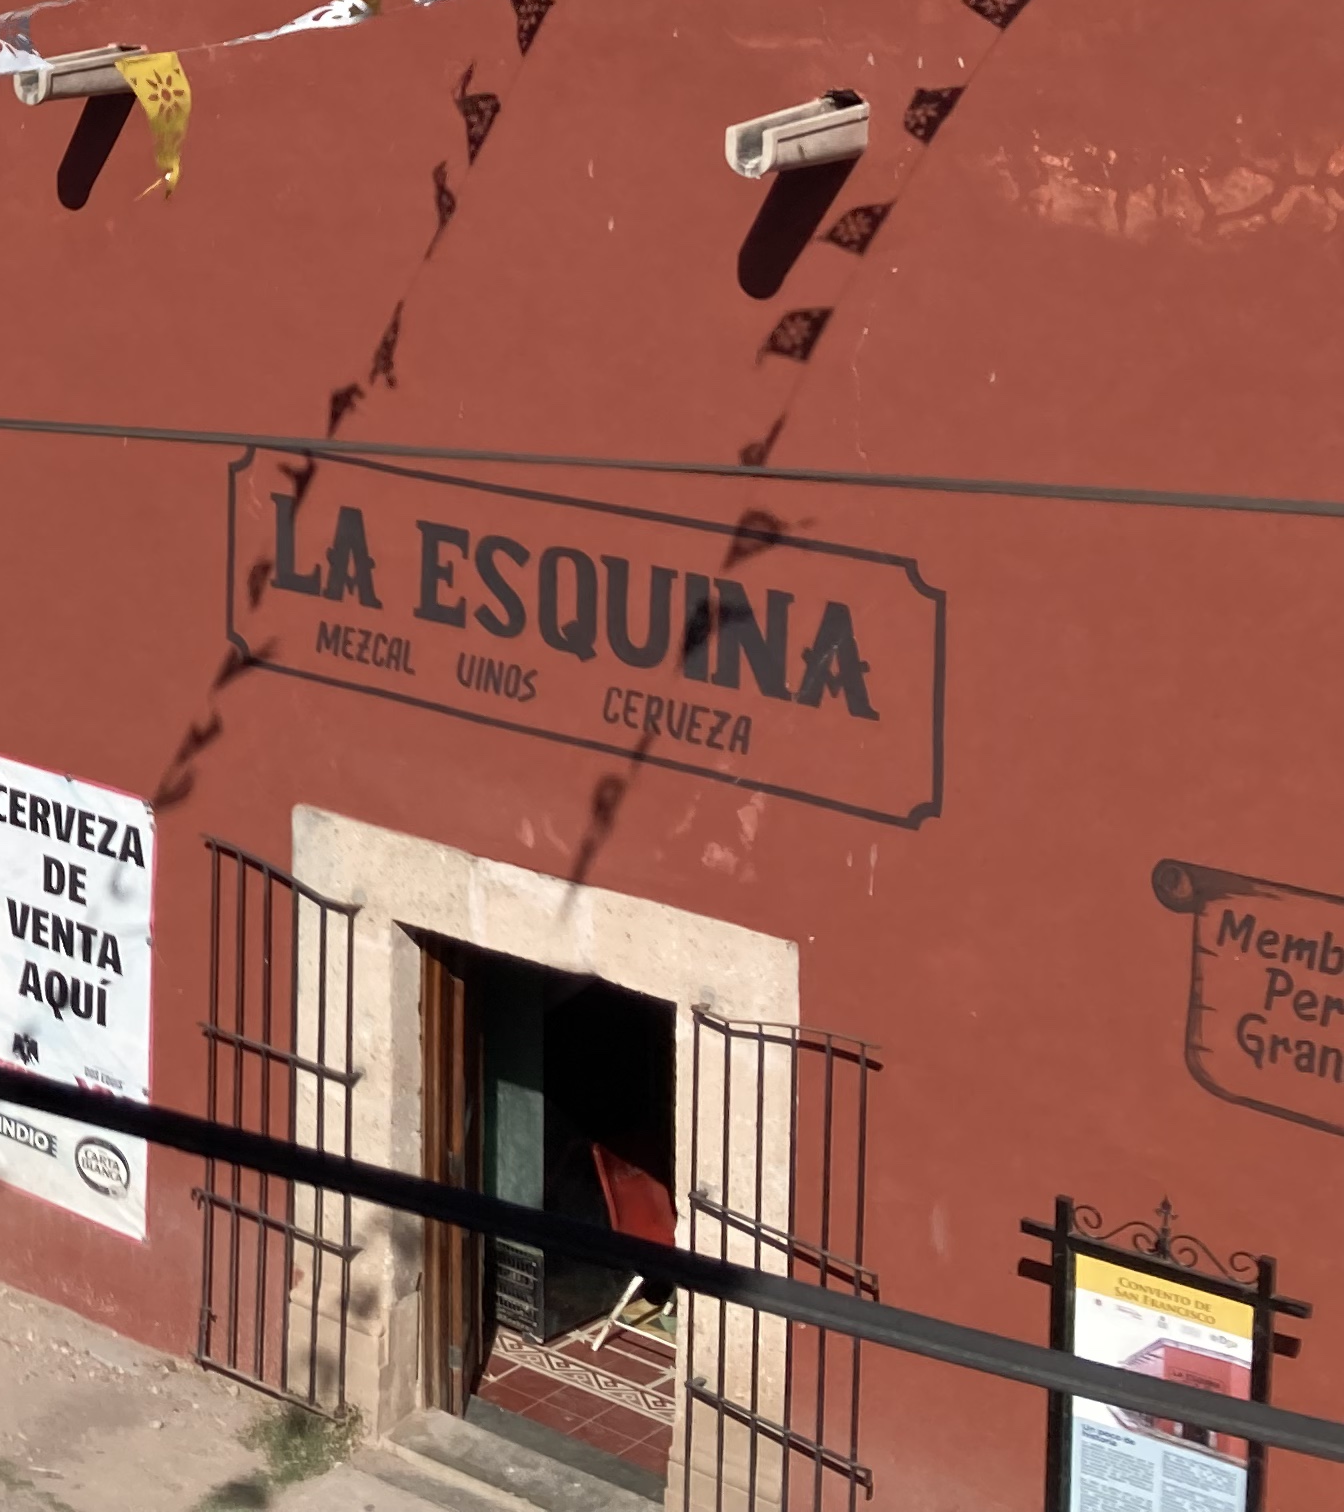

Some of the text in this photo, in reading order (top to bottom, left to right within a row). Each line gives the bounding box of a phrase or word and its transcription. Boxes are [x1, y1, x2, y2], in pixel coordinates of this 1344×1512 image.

[269, 491, 880, 722] LA ESQUINA
[315, 621, 416, 676] MEZCAL
[42, 854, 87, 906] DE
[6, 896, 123, 977] VENTA
[18, 959, 113, 1028] AQUÍ
[82, 1148, 119, 1172] CARTA
[1114, 1285, 1140, 1303] SAN
[1143, 1294, 1217, 1326] FRANCISCO
[1118, 1276, 1213, 1314] CONVENTO DE
